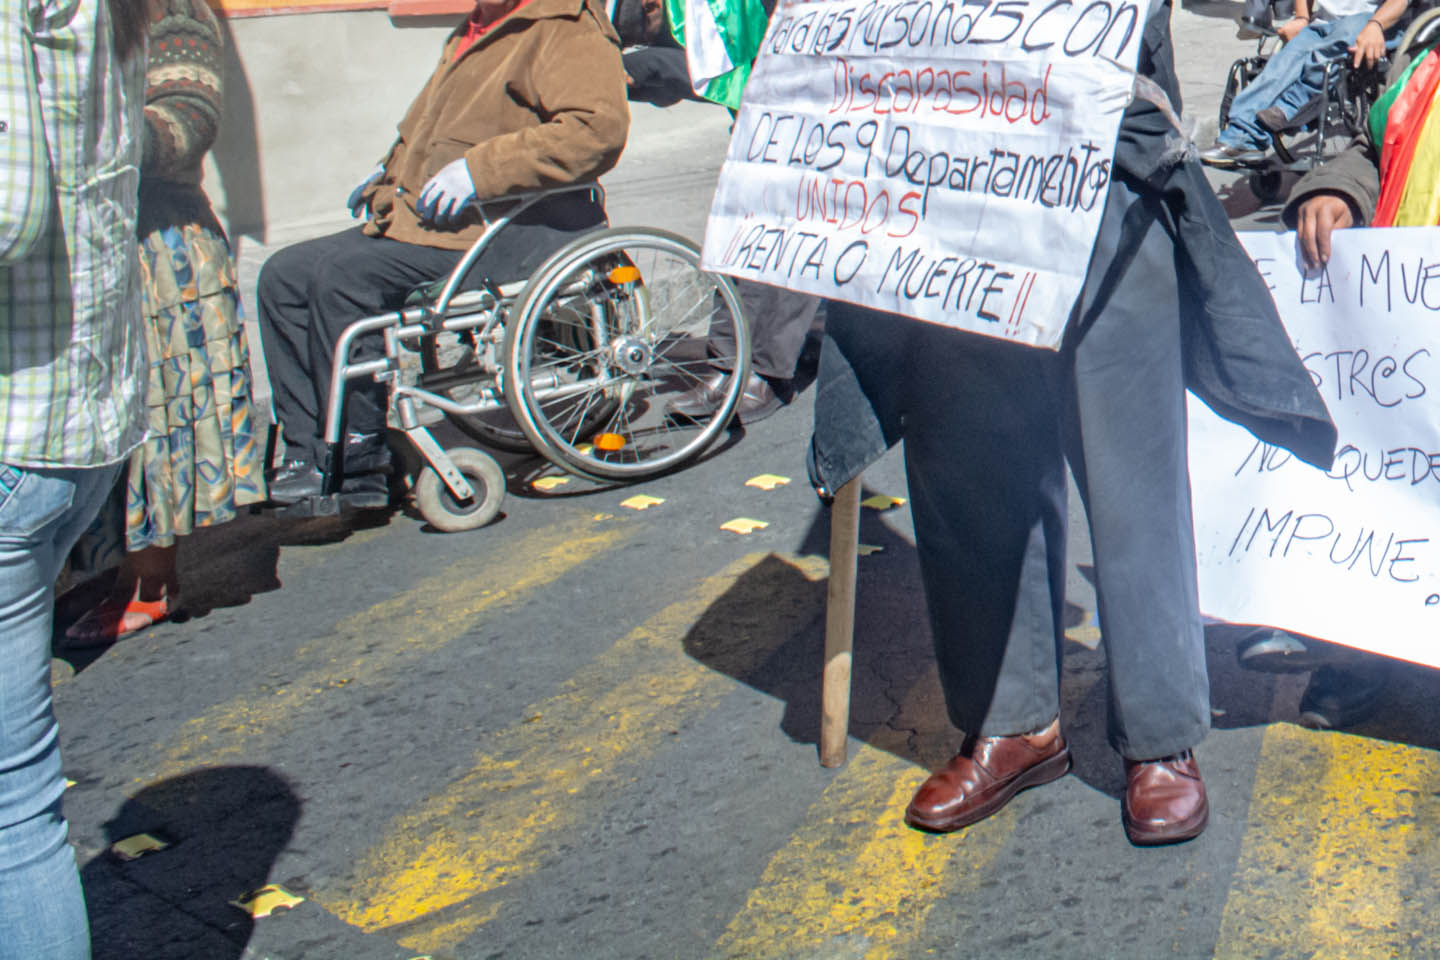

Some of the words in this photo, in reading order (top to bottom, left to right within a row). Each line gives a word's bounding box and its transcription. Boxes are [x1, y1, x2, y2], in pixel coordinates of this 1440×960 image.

[829, 56, 1052, 126] Discapasidad
[746, 112, 795, 163] DE
[833, 240, 869, 288] O
[1299, 262, 1335, 305] LA
